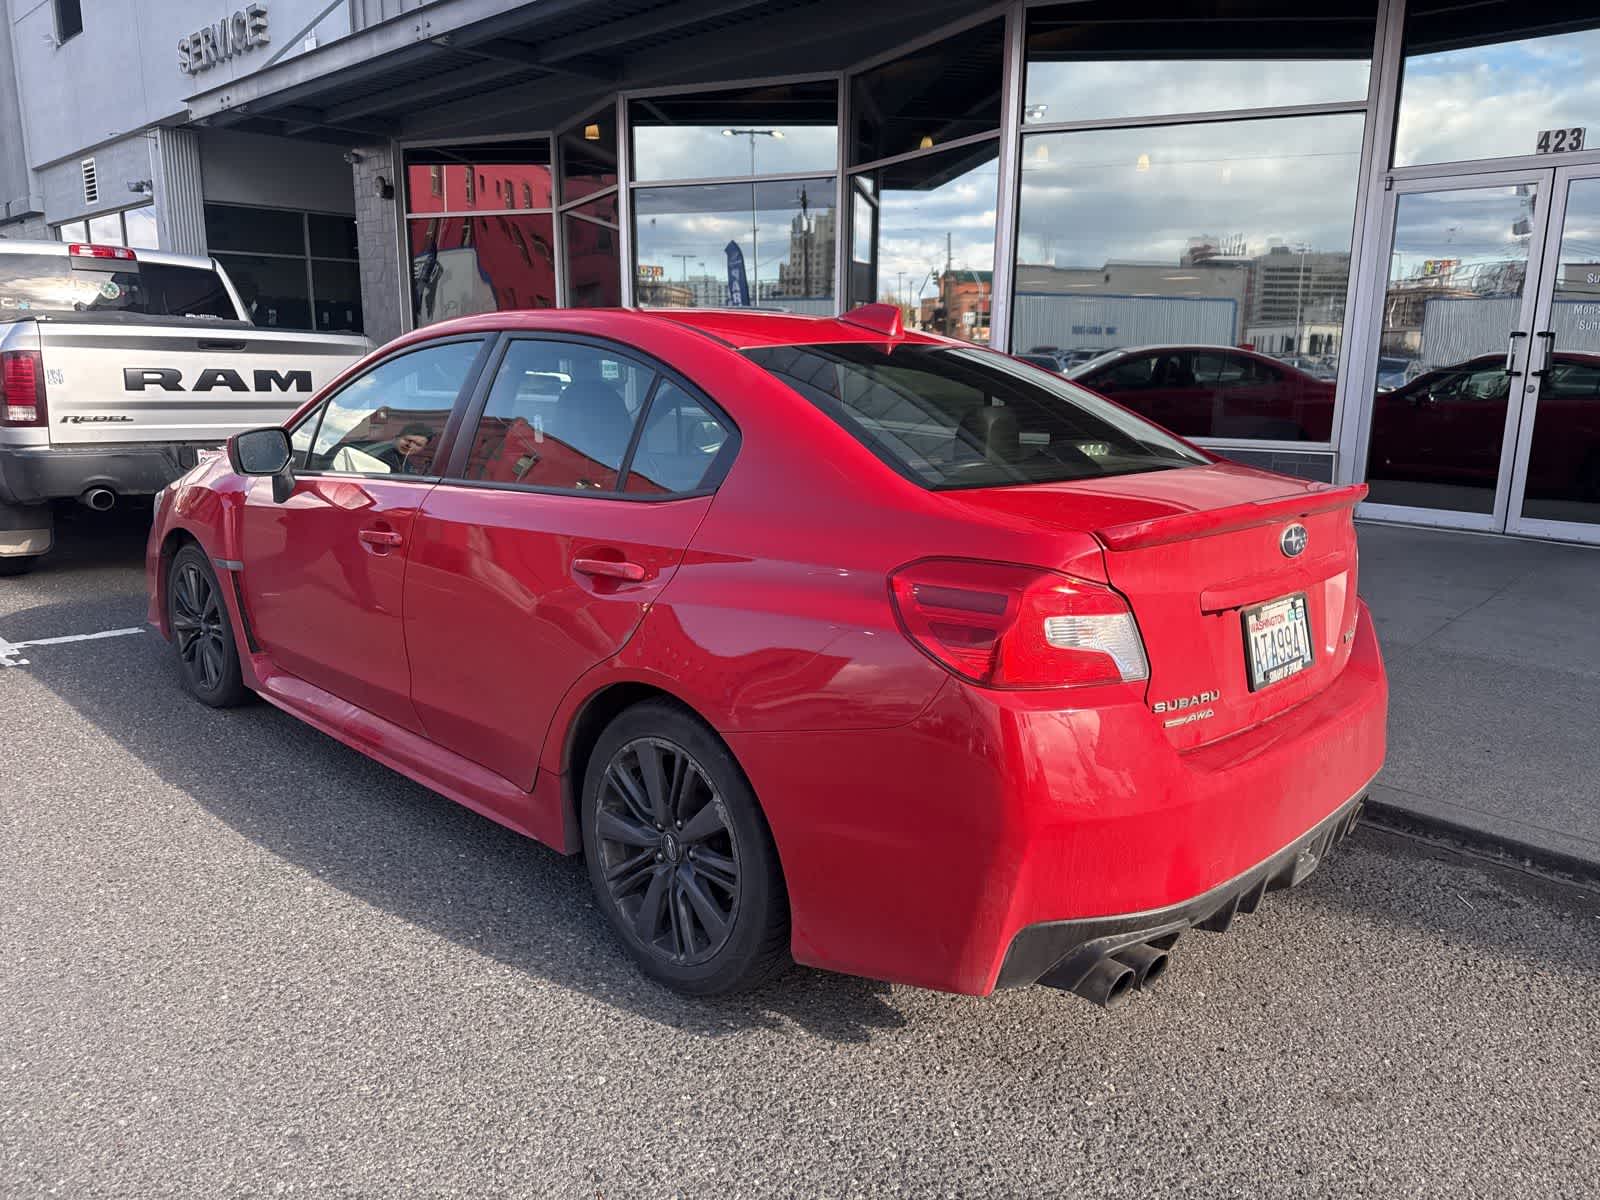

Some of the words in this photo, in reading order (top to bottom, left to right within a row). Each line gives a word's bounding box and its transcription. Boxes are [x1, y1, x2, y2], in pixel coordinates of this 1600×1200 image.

[178, 3, 269, 74] SERVICE
[1537, 127, 1582, 153] 423
[1579, 320, 1600, 330] Sun
[123, 368, 313, 392] RAM
[60, 416, 134, 424] REBEL
[1250, 613, 1286, 633] WASHINGTON
[1152, 688, 1220, 713] SUBARU
